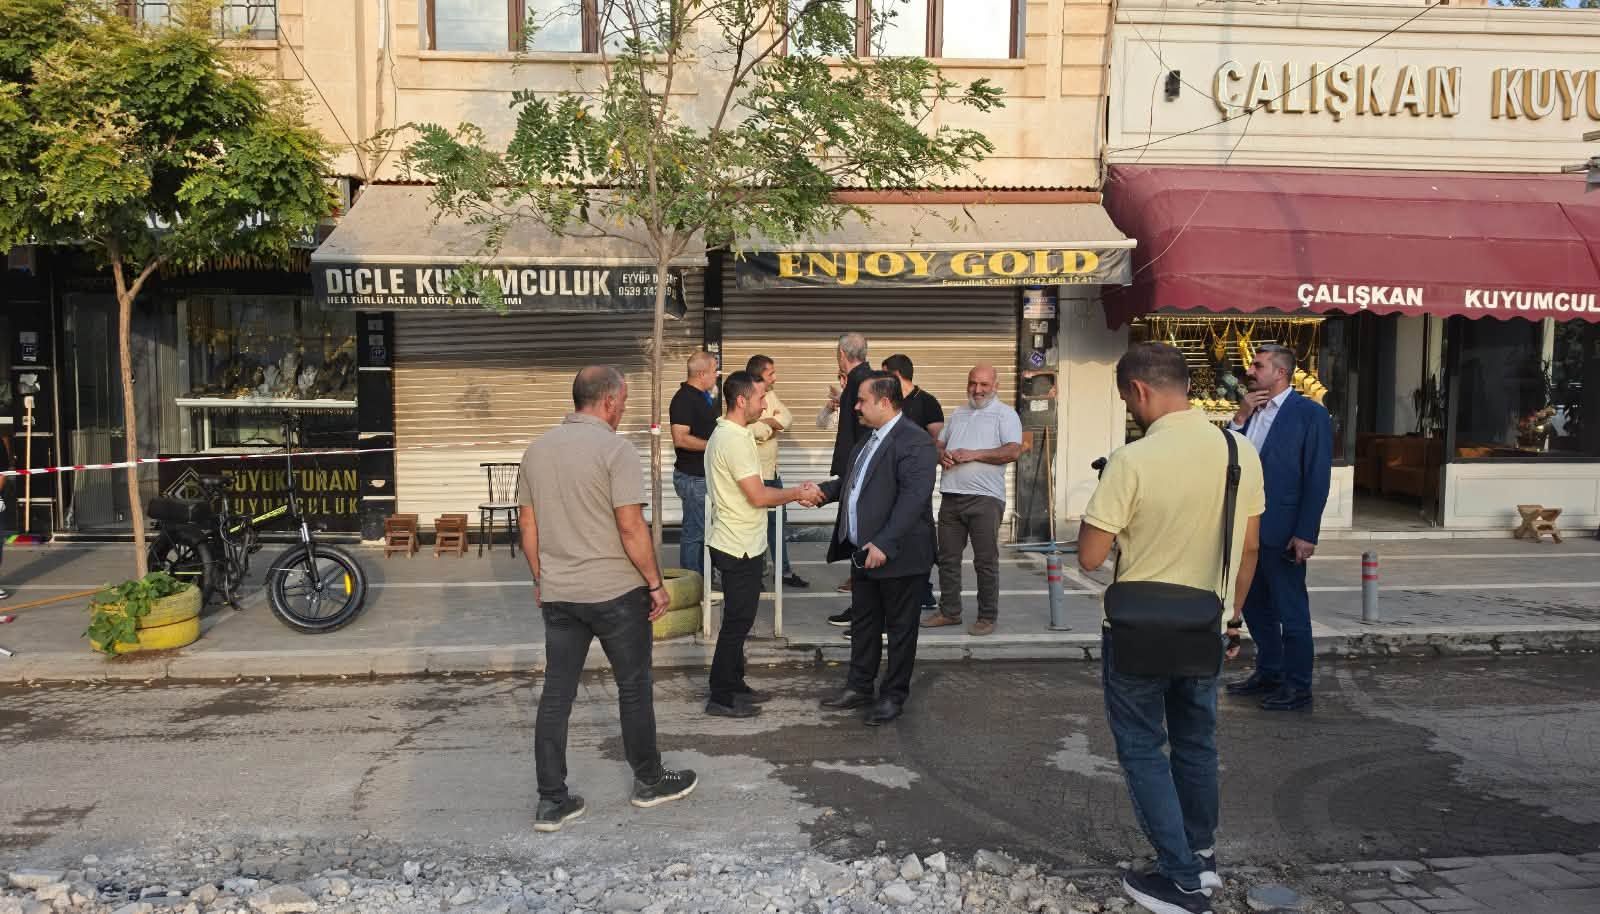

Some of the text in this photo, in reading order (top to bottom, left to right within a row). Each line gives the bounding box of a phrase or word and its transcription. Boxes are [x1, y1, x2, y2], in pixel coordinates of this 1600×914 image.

[1214, 60, 1462, 121] ÇALIŞKAN
[776, 250, 1099, 284] ENJOY GOLD
[327, 296, 349, 305] HER
[351, 294, 384, 305] TÜRLÜ
[387, 296, 417, 305] ALTIN
[1297, 284, 1600, 312] ÇALIŞKAN KUYUMCUL
